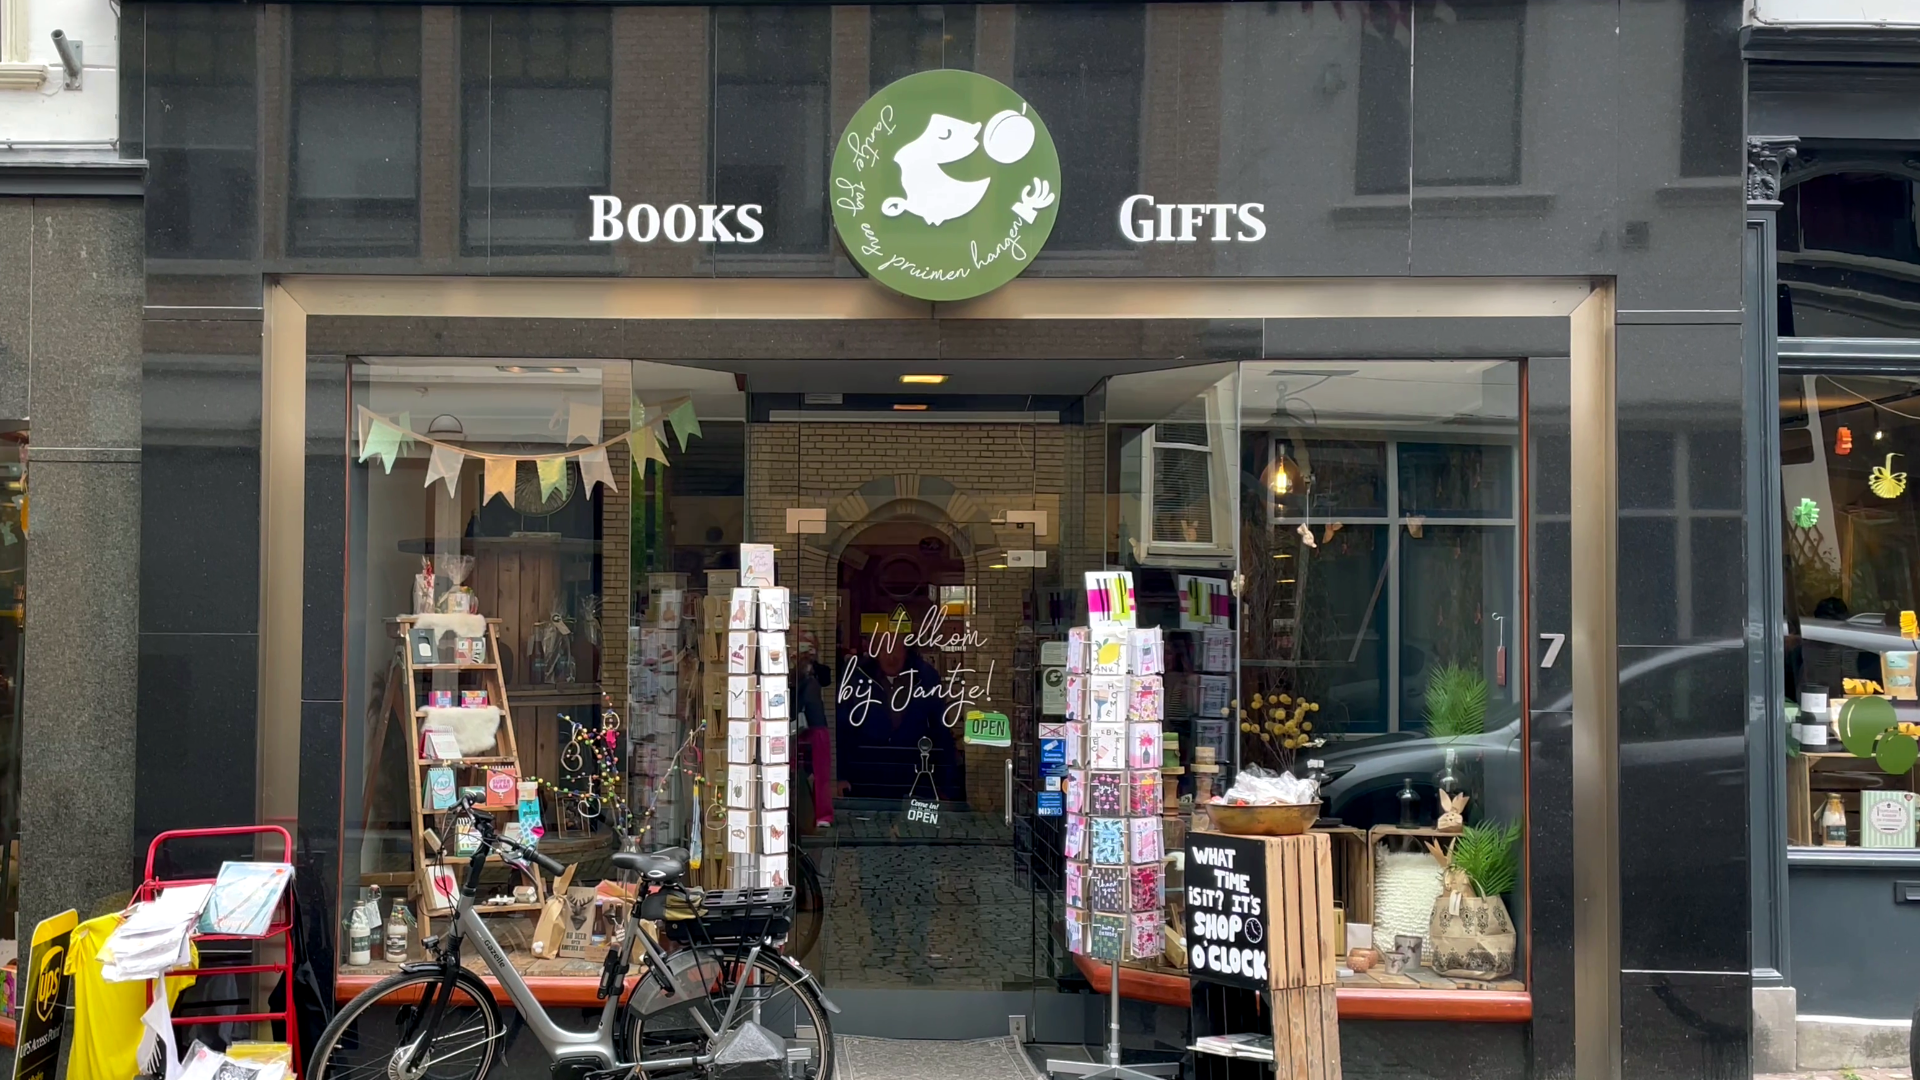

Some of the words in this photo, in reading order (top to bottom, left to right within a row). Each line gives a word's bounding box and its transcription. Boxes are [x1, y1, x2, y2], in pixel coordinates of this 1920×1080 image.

[848, 105, 896, 172] Jantje
[836, 177, 865, 217] zag
[588, 195, 764, 243] BOOKS
[1119, 194, 1267, 242] GIFTS
[861, 222, 883, 256] eens
[971, 216, 1027, 269] hangen
[878, 254, 970, 281] pruimen
[868, 604, 988, 658] Welkom
[1540, 633, 1565, 668] 7
[838, 655, 882, 727] bij
[891, 659, 996, 728] Jantje!
[972, 719, 1006, 737] OPEN
[907, 809, 938, 825] OPEN
[910, 799, 929, 809] Come
[929, 802, 939, 810] in!
[1192, 846, 1236, 869] WHAT
[1232, 894, 1261, 915] IT'S
[1193, 911, 1242, 942] SHOP
[484, 939, 506, 969] Gazelle
[1192, 940, 1268, 981] O'CLOCK
[39, 967, 60, 1010] ups
[20, 1040, 32, 1058] UPS
